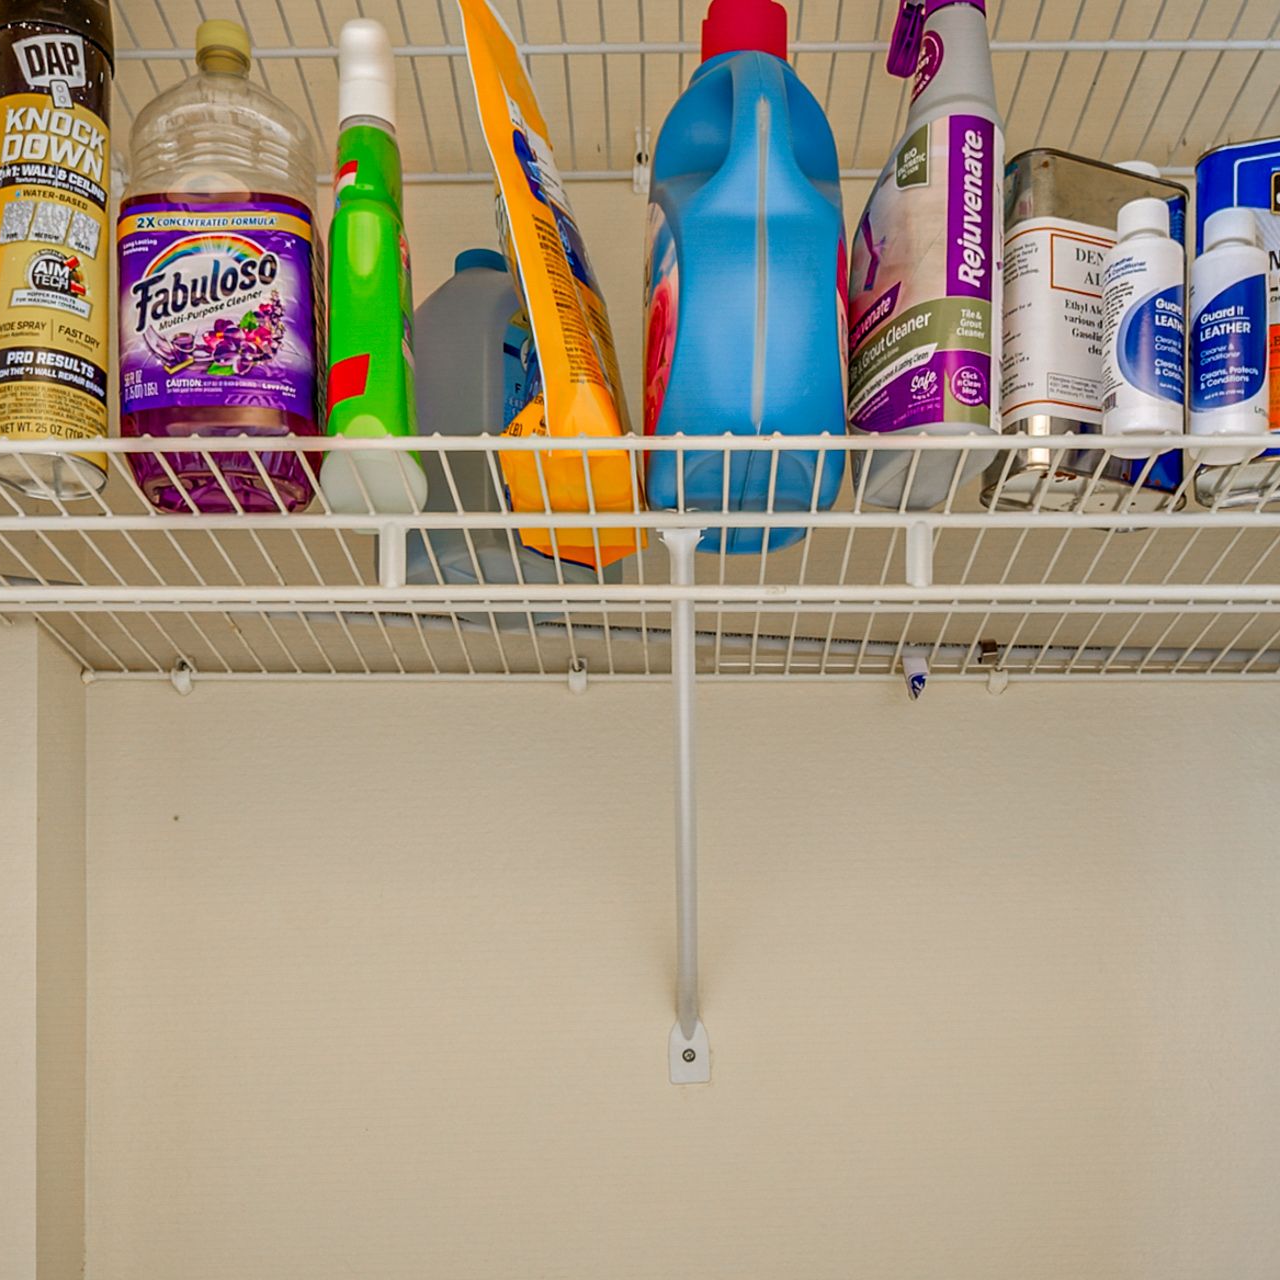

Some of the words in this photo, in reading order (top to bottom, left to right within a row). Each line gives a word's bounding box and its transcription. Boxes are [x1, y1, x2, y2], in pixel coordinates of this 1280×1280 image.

[23, 41, 80, 79] DAP
[5, 107, 105, 154] KNOCK
[1, 134, 104, 182] DOWN
[23, 188, 88, 211] WATER-BASED
[958, 129, 985, 288] Rejuvenate
[136, 216, 155, 229] 2X
[157, 217, 228, 228] CONCENTRATED
[231, 216, 275, 226] FORMULA
[33, 272, 69, 290] TECH
[34, 260, 69, 279] AIM
[132, 253, 278, 333] Fabuloso
[158, 302, 225, 331] Multi-Purpose
[226, 290, 263, 308] Cleaner
[960, 308, 974, 319] Tile
[1200, 306, 1235, 325] Guard
[16, 319, 47, 332] SPRAY
[956, 327, 985, 339] Cleaner
[959, 318, 983, 329] Grout
[1199, 322, 1252, 342] LEATHER
[57, 324, 83, 341] FAST
[84, 333, 100, 349] DRY
[6, 351, 34, 365] PRO
[35, 351, 95, 378] RESULTS
[910, 370, 937, 393] Safe
